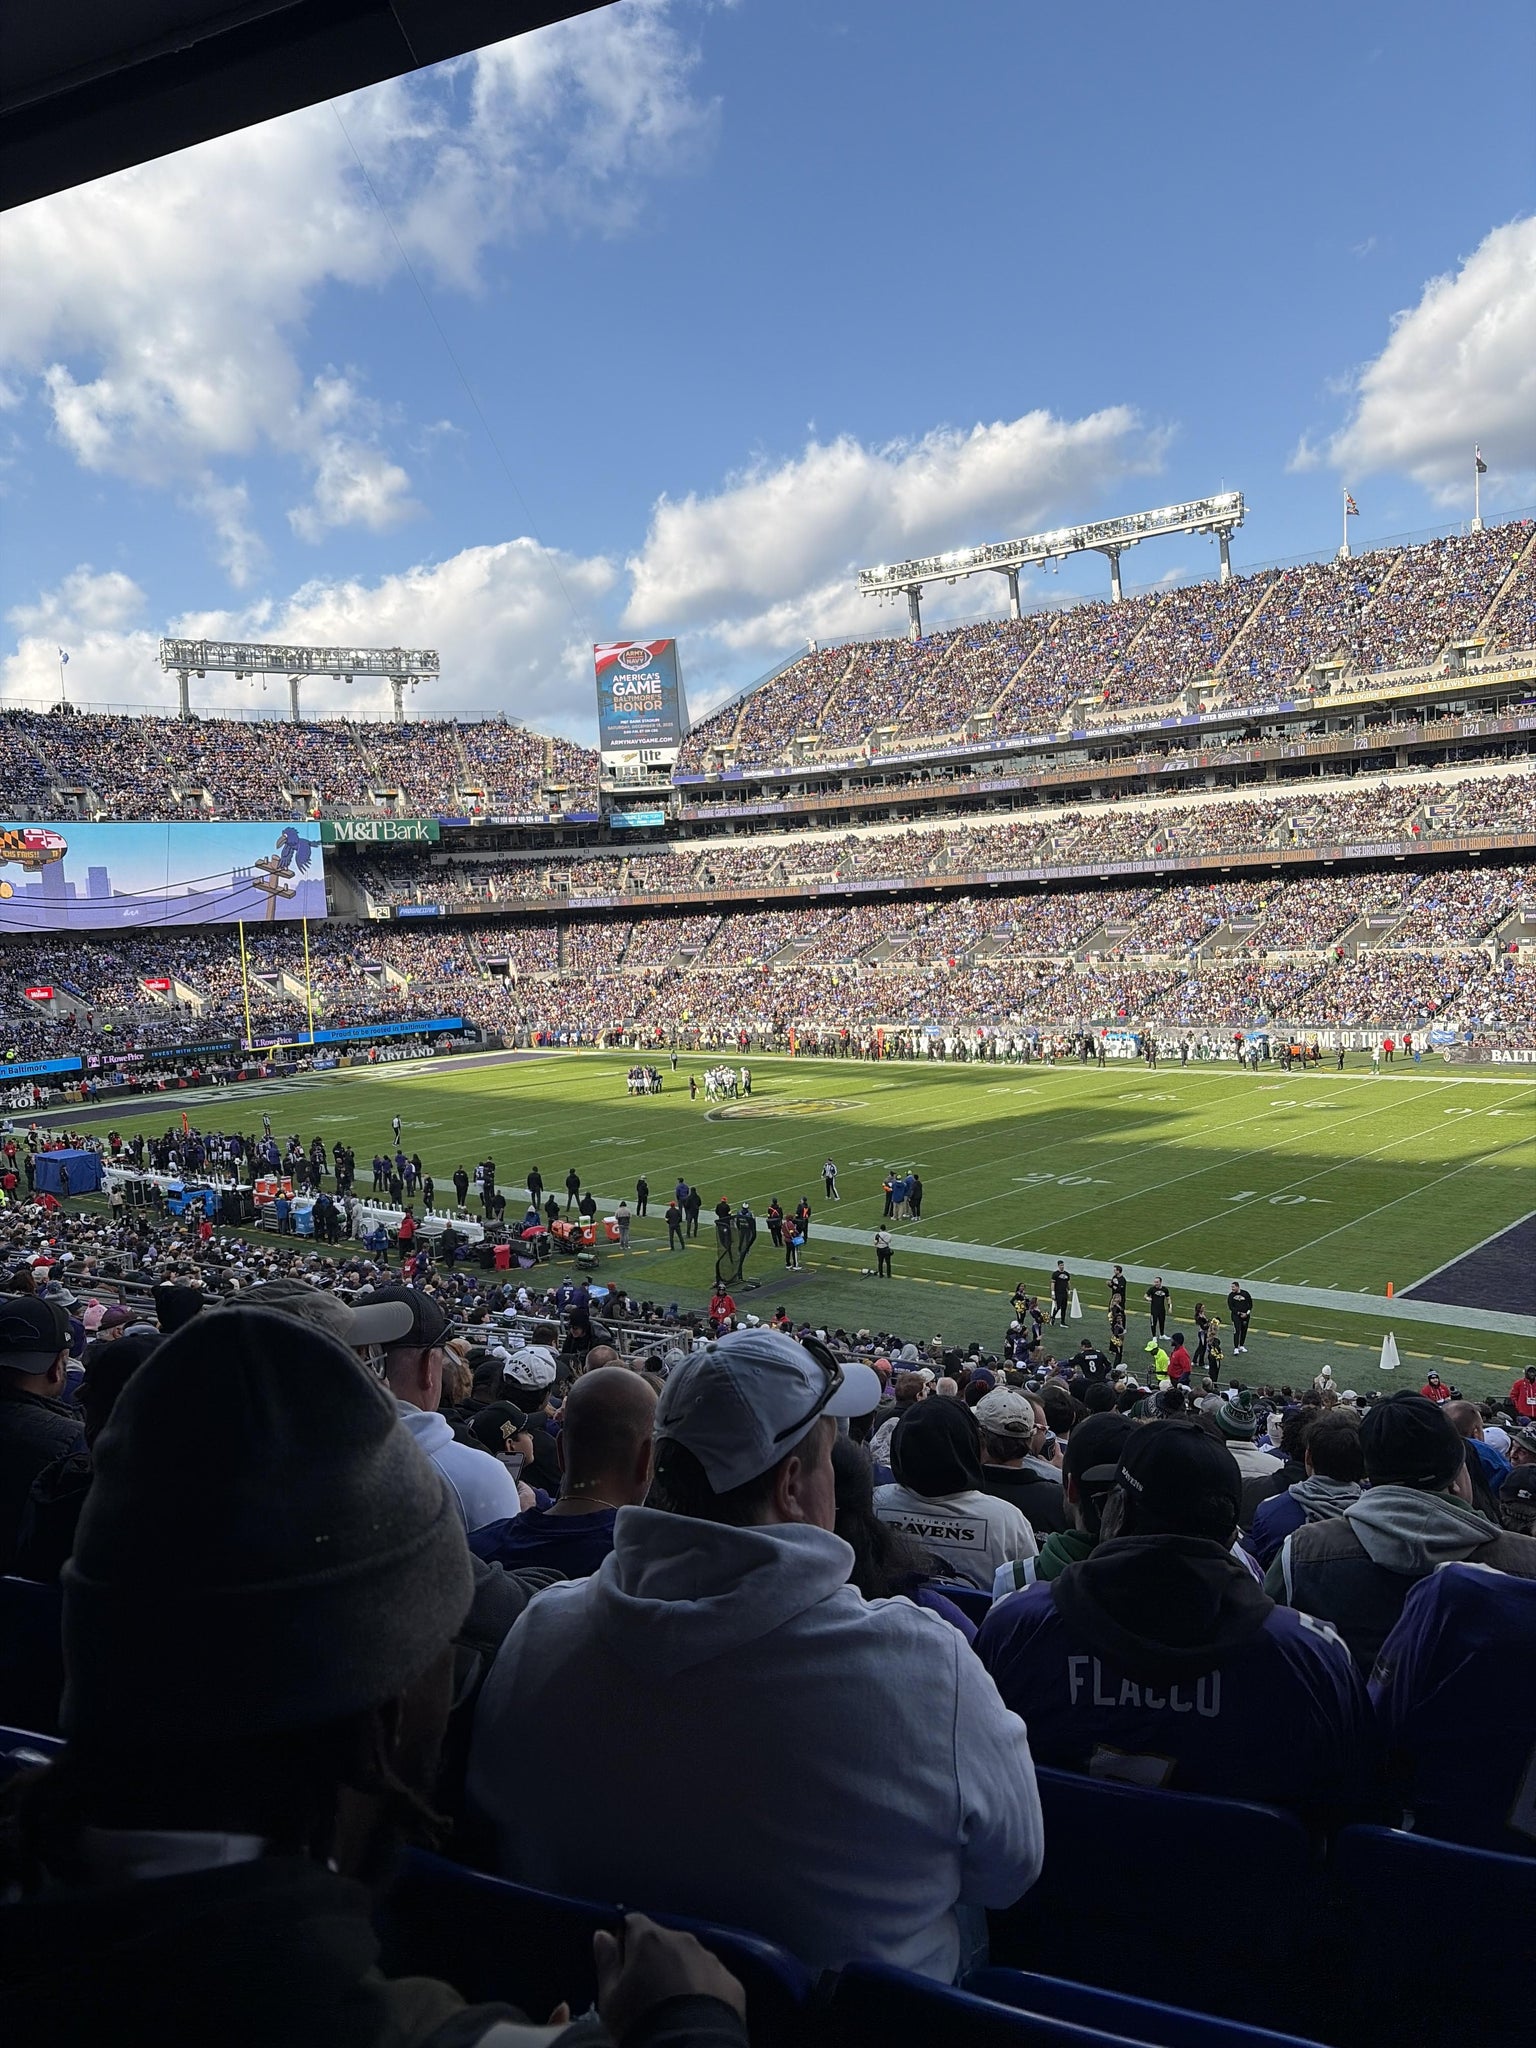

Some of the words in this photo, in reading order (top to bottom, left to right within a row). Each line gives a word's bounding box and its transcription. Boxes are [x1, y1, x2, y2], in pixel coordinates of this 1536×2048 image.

[613, 673, 660, 682] AMERICA'S
[1518, 670, 1528, 678] ED
[612, 680, 662, 696] GAME
[1443, 679, 1465, 688] LEWIS
[613, 694, 662, 703] BALTIMORE'S
[1324, 695, 1355, 705] JONATHAN
[1356, 692, 1378, 701] OGDEN
[614, 701, 662, 712] HONOR
[1200, 714, 1217, 722] PETER
[1218, 710, 1248, 720] BOULWARE
[1249, 705, 1280, 716] 1997-2005
[1424, 726, 1455, 741] TIMEOUT
[1462, 724, 1480, 737] 0:24
[610, 737, 673, 746] ARMYNAVYGAME.COM
[1297, 744, 1305, 756] 10
[1330, 741, 1339, 753] 37
[1354, 737, 1368, 750] 7:28
[640, 749, 661, 764] Lite
[333, 821, 382, 841] M&T
[384, 820, 430, 841] Bank
[1432, 839, 1457, 851] DONATE
[1459, 838, 1467, 849] TO
[1469, 837, 1492, 849] HONOR
[1494, 834, 1515, 848] THOSE
[1517, 833, 1535, 846] WHO
[1223, 853, 1242, 866] CORPS
[1242, 851, 1281, 864] SCHOLARSHIP
[1281, 849, 1317, 862] FOUNDATION
[1072, 866, 1092, 877] SERVED
[1103, 863, 1132, 874] SACRIFICED
[1132, 862, 1144, 872] FOR
[1143, 861, 1155, 871] OUR
[1156, 859, 1176, 870] NATION
[376, 907, 389, 917] 29
[400, 906, 437, 916] PROGRESSIVE
[331, 1030, 351, 1039] Proud
[352, 1029, 360, 1037] to
[361, 1028, 369, 1036] be
[369, 1026, 392, 1035] rooted
[393, 1025, 400, 1033] in
[400, 1022, 432, 1032] Baltimore
[1297, 1031, 1337, 1048] HME
[1341, 1031, 1357, 1049] OF
[1360, 1032, 1384, 1049] THE
[193, 1044, 232, 1053] CONFIDENCE
[368, 1047, 435, 1063] ARYLAND
[8, 1064, 48, 1076] Baltimore
[848, 1157, 916, 1170] 30
[1011, 1172, 1093, 1186] 20
[1220, 1190, 1307, 1206] 10
[583, 1228, 593, 1239] G
[564, 1291, 571, 1301] 5
[1088, 1360, 1097, 1373] 8
[903, 1516, 960, 1527] BALTIMORE
